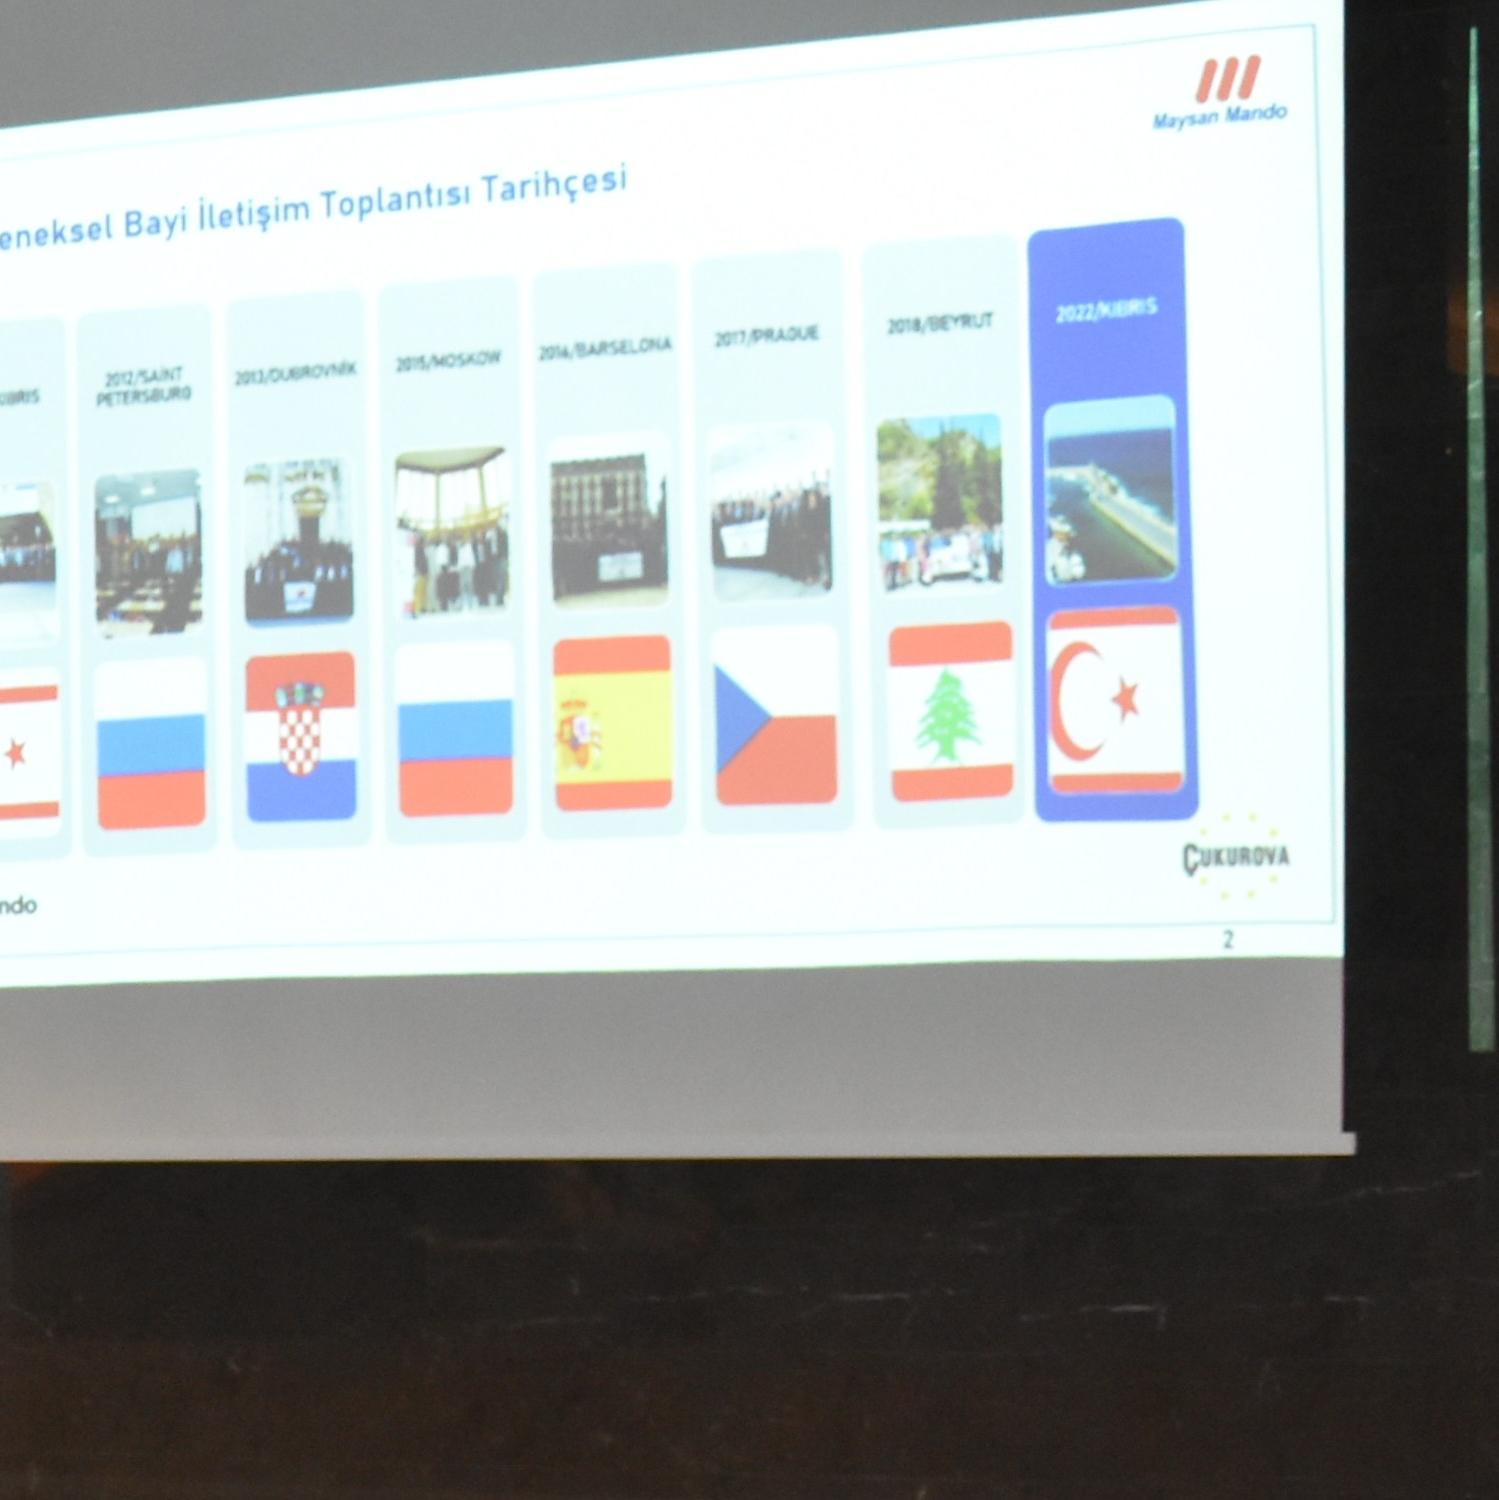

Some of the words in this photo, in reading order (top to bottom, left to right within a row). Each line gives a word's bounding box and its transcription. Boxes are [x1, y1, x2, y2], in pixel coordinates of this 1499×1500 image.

[1153, 112, 1219, 132] Maysan
[1225, 103, 1288, 122] Mando
[124, 206, 187, 241] Bayi
[199, 196, 310, 233] İletişim
[320, 183, 470, 223] Toplantısı
[481, 162, 627, 203] Tarihçesi
[1182, 843, 1290, 877] ÇUKUROVA
[1223, 929, 1235, 949] 2
